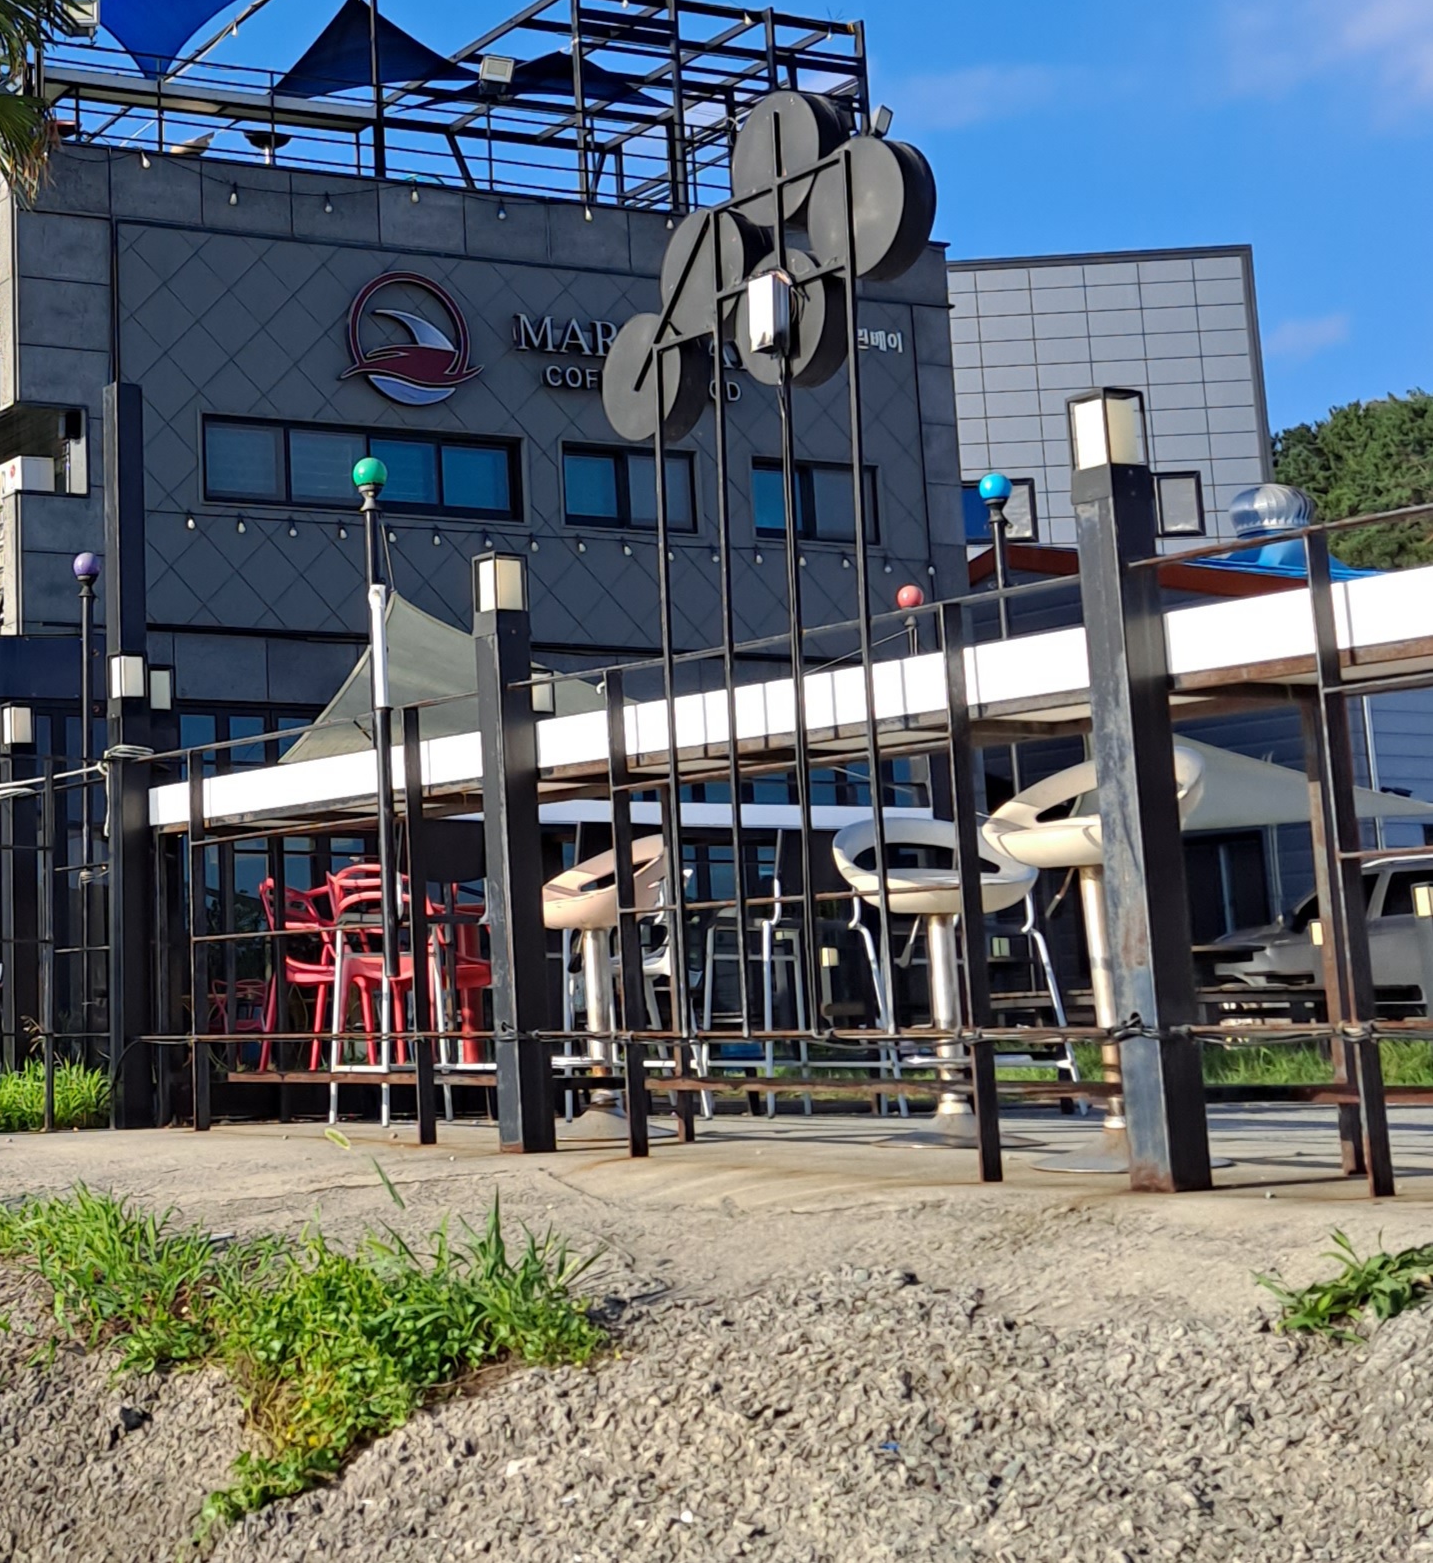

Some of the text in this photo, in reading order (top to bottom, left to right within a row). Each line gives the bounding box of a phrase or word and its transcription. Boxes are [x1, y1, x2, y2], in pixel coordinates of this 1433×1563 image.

[515, 313, 618, 357] MAR
[857, 327, 904, 354] 린베이
[545, 364, 600, 389] COF
